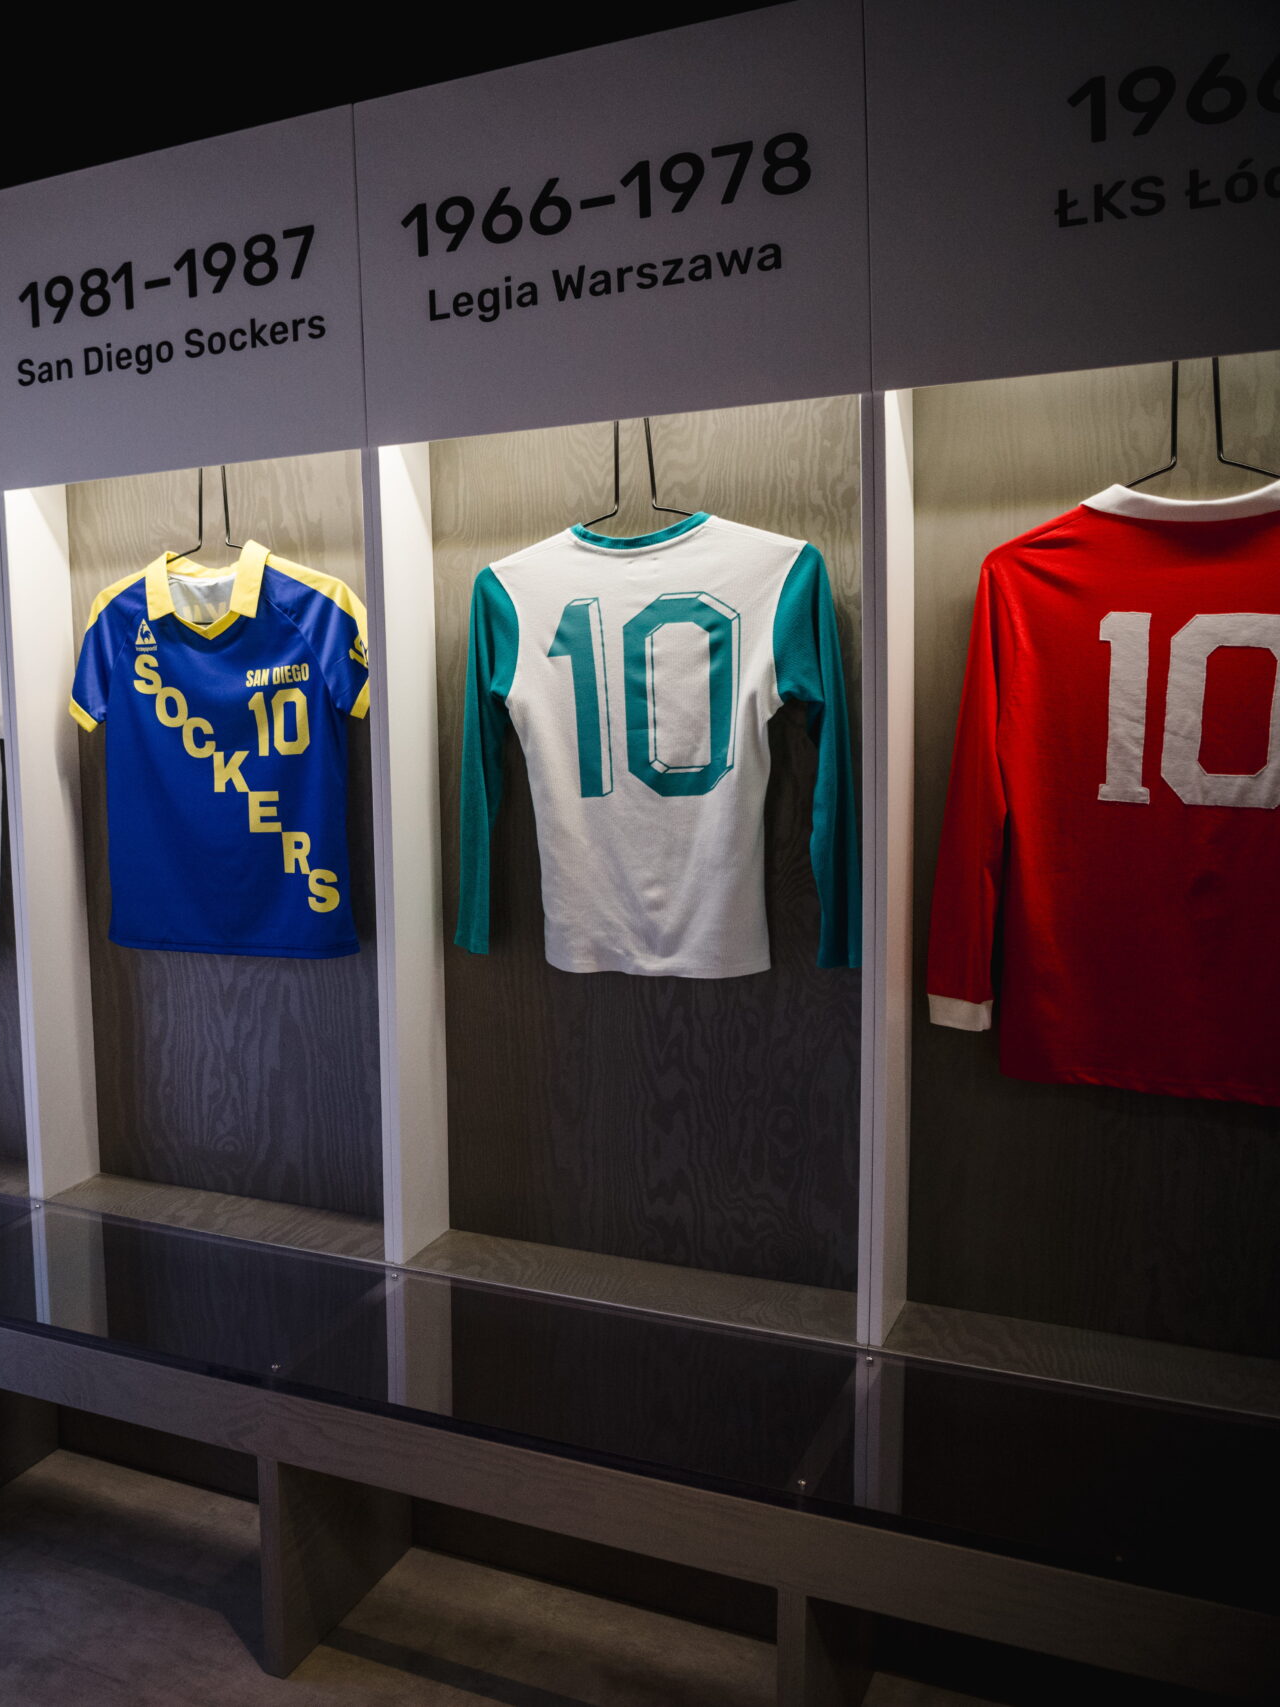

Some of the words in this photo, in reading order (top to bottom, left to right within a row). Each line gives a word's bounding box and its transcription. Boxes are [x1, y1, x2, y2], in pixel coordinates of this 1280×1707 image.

[1053, 175, 1167, 228] ŁKS
[428, 275, 539, 323] Legia
[551, 242, 783, 302] Warszawa
[17, 358, 74, 387] San
[83, 340, 174, 376] Diego
[184, 314, 327, 359] Sockers
[245, 668, 270, 688] SAN
[272, 663, 310, 685] DIEGO
[546, 591, 741, 798] 10
[1096, 610, 1280, 809] 10
[247, 687, 311, 757] 10
[133, 653, 341, 913] SOCKERS
